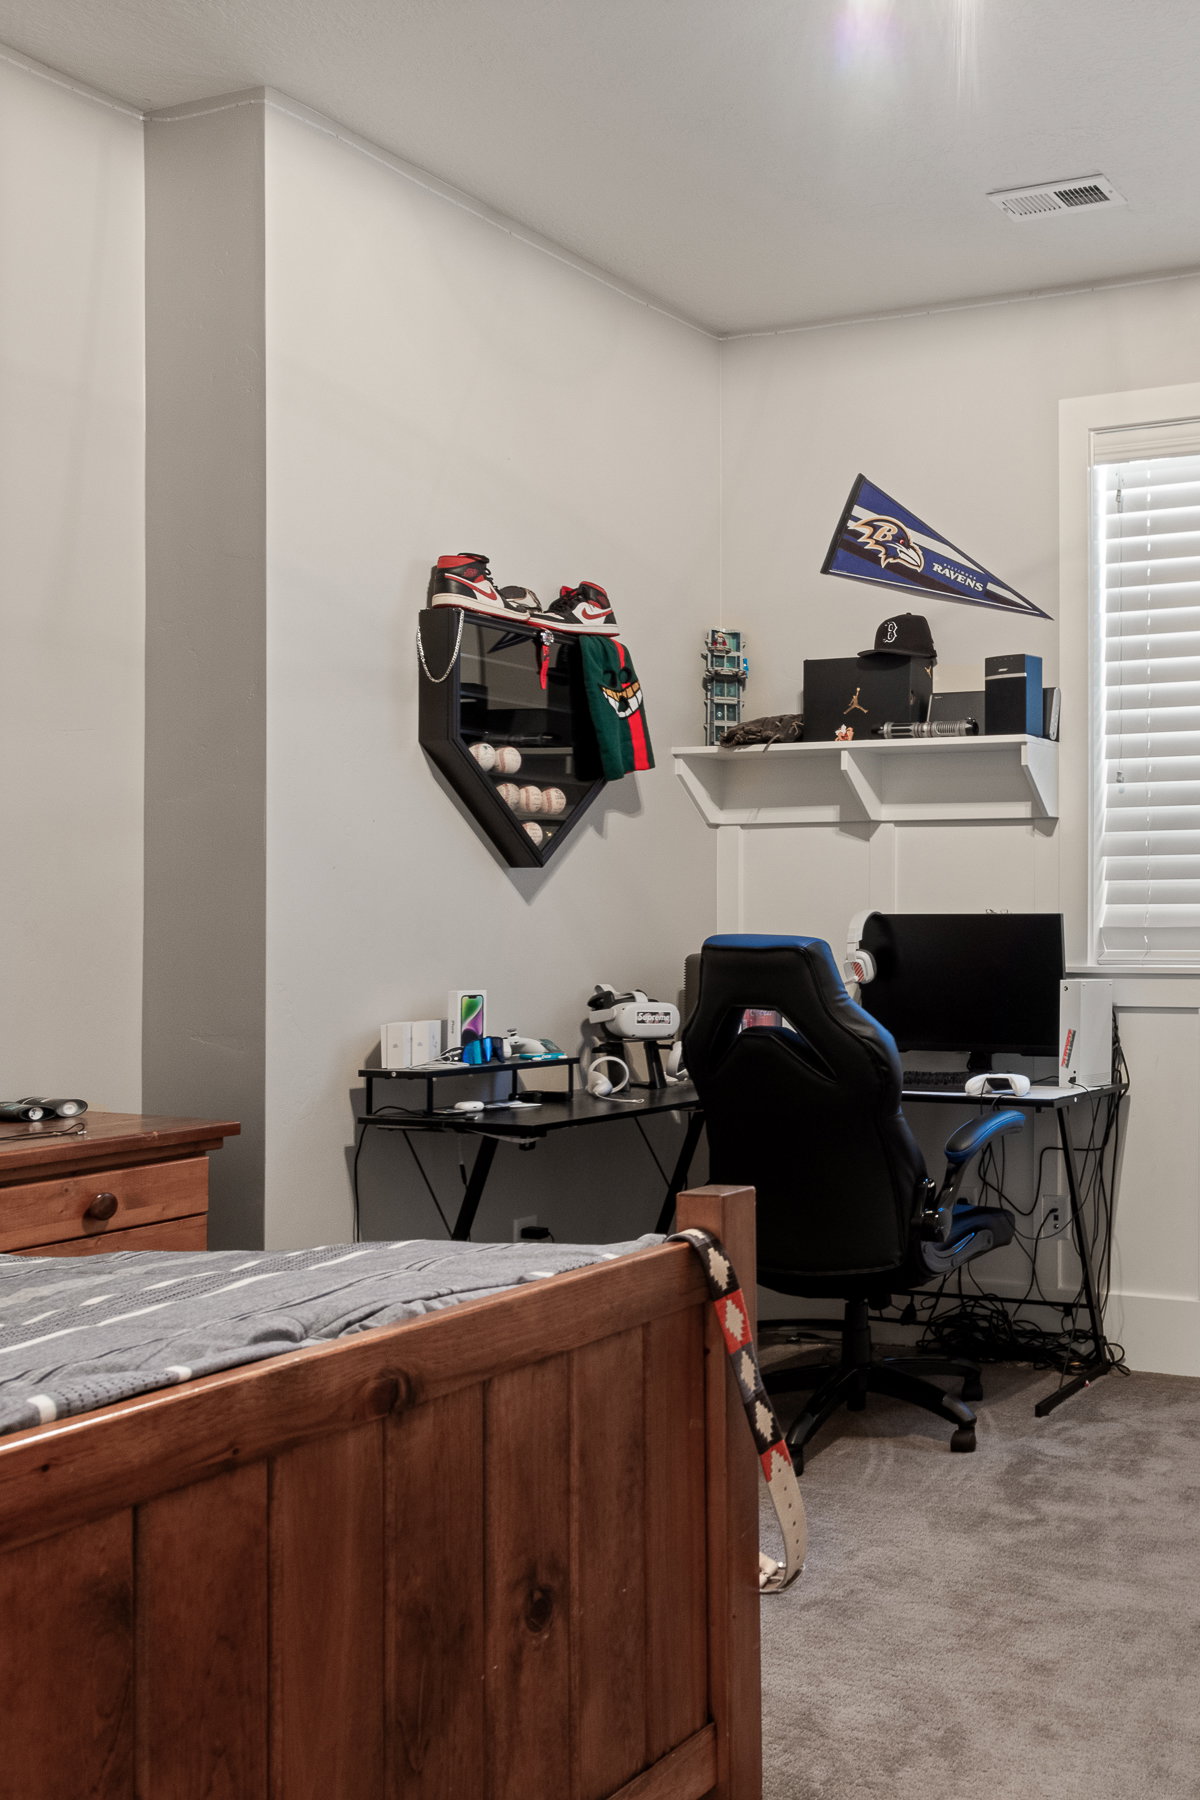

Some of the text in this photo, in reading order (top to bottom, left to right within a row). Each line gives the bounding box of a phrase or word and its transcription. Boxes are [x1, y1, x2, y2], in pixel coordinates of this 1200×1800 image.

[932, 562, 984, 592] RAVENS
[883, 620, 898, 643] B
[637, 1011, 671, 1024] Supreme
